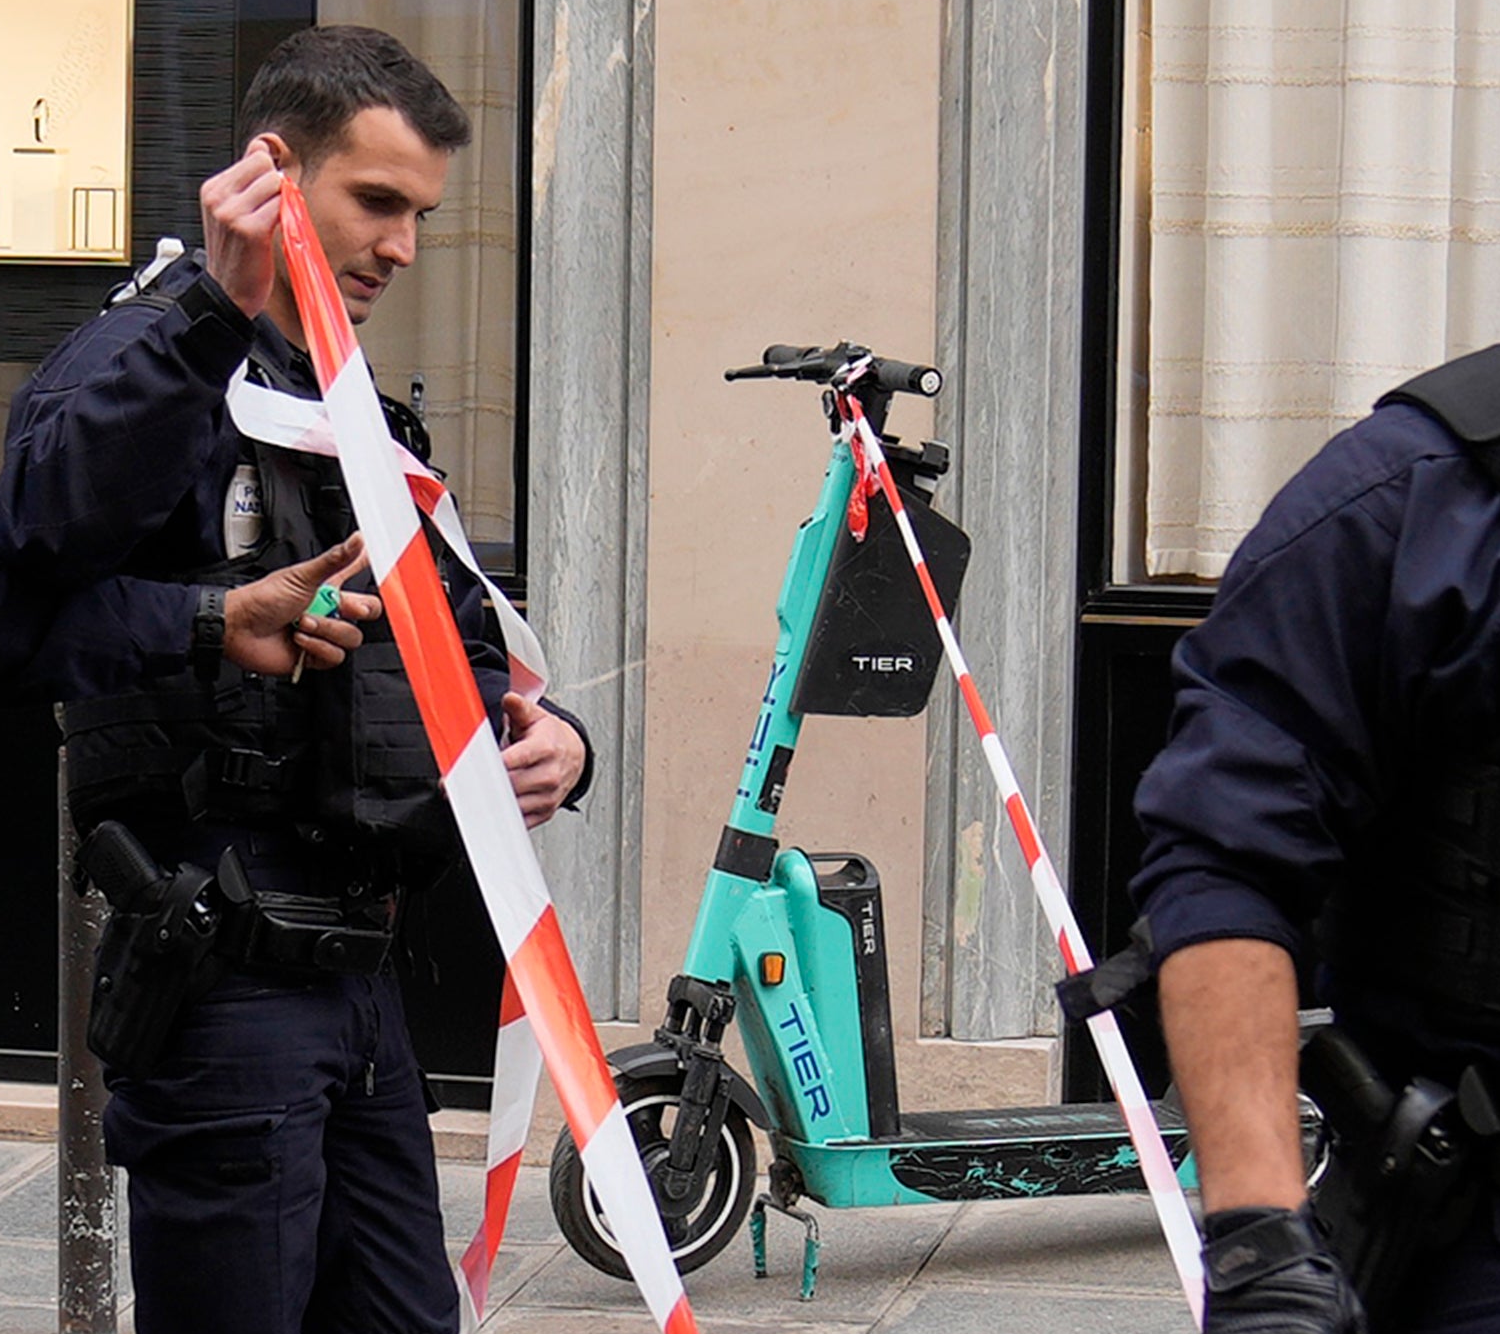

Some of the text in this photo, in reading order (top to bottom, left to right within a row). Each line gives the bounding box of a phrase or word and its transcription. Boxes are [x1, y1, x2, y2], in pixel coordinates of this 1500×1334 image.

[852, 656, 913, 672] TIER
[861, 900, 877, 955] TIER
[779, 1002, 831, 1123] TIER
